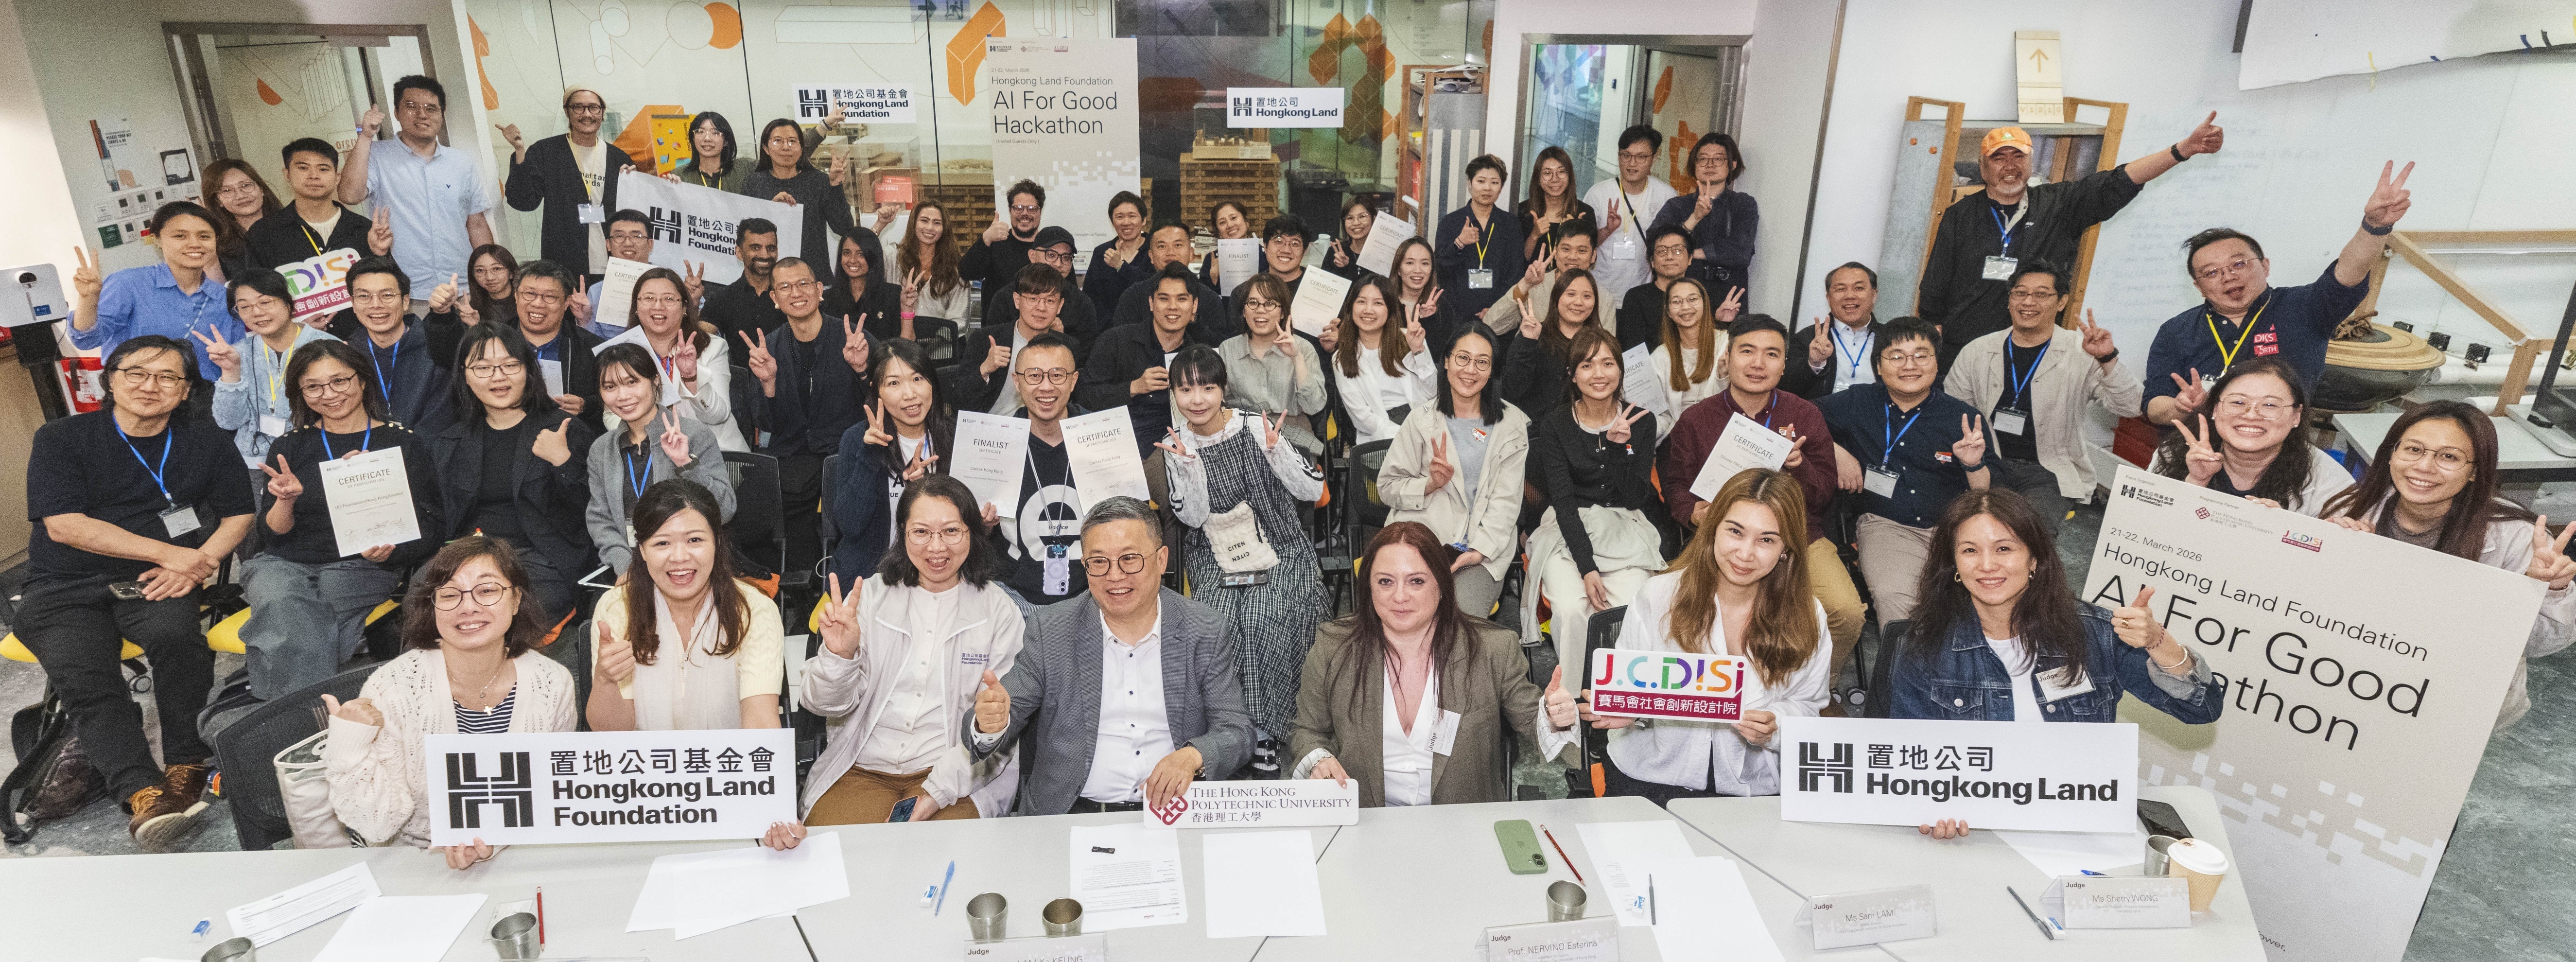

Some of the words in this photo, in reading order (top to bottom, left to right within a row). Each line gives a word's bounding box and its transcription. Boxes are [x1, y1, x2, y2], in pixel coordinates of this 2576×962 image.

[992, 76, 1037, 87] Hongkong
[1040, 76, 1061, 85] Land
[1064, 76, 1113, 85] Foundation
[832, 89, 907, 99] 置地公司基金會
[993, 90, 1014, 109] AI
[1024, 90, 1056, 109] For
[1062, 90, 1117, 110] Good
[835, 100, 884, 109] Hongkong
[1256, 97, 1298, 107] 置地公司
[1256, 108, 1310, 119] Hongkong
[1312, 108, 1338, 116] Land
[994, 115, 1103, 134] Hackathon
[687, 214, 739, 236] 置地公司
[1380, 225, 1404, 238] CERTIFICATE
[688, 227, 735, 245] Hongkon
[688, 238, 735, 256] Foundati
[615, 272, 639, 281] CERTIFIC
[1310, 280, 1339, 295] CERTIFICATE
[1078, 428, 1121, 444] CERTIFICATE
[1091, 438, 1116, 446] PARTICIPATION
[974, 438, 1009, 449] FINALIST
[1734, 435, 1774, 460] CERTIFICATE
[1741, 447, 1765, 461] PARTICIPATION
[339, 469, 391, 485] CERTIFICATE
[354, 478, 384, 488] PARTICIPATION
[2136, 497, 2162, 507] Foundation
[2138, 488, 2174, 502] 置地公司基金會
[2138, 492, 2161, 503] Hongkong
[2199, 495, 2224, 506] Programme
[1228, 541, 1246, 551] CITEN
[2110, 527, 2139, 544] 21-22,
[2143, 536, 2175, 553] March
[2176, 546, 2203, 562] 2026
[2104, 543, 2213, 594] Hongkong
[2221, 580, 2278, 612] Land
[2284, 600, 2428, 662] Foundation
[2163, 594, 2251, 652] For
[2265, 631, 2431, 718] Good
[2039, 673, 2058, 682] Judge
[1598, 694, 1737, 715] 賽馬會社會創新設計院
[1428, 732, 1437, 750] Judge
[550, 746, 776, 776] 置地公司基金會
[1867, 744, 1993, 772] 置地公司
[552, 778, 701, 804] Hongkong
[706, 776, 776, 797] Land
[1191, 787, 1218, 798] THE
[1220, 787, 1258, 798] HONG
[1260, 787, 1296, 797] KONG
[1867, 773, 2032, 805] Hongkong
[2038, 778, 2118, 802] Land
[1191, 799, 1277, 810] POLYTECHNIC
[1279, 798, 1352, 809] UNIVERSITY
[554, 804, 717, 826] Foundation
[1191, 811, 1262, 823] 香港理工大學
[2106, 895, 2130, 903] Sherry
[2131, 894, 2158, 902] WONG
[1859, 912, 1875, 921] Sam
[1877, 910, 1894, 918] LAM
[1508, 947, 1525, 956] Prof.
[1528, 943, 1565, 954] NERVINO
[1567, 940, 1597, 949] Esterina
[2258, 930, 2286, 952] ower,
